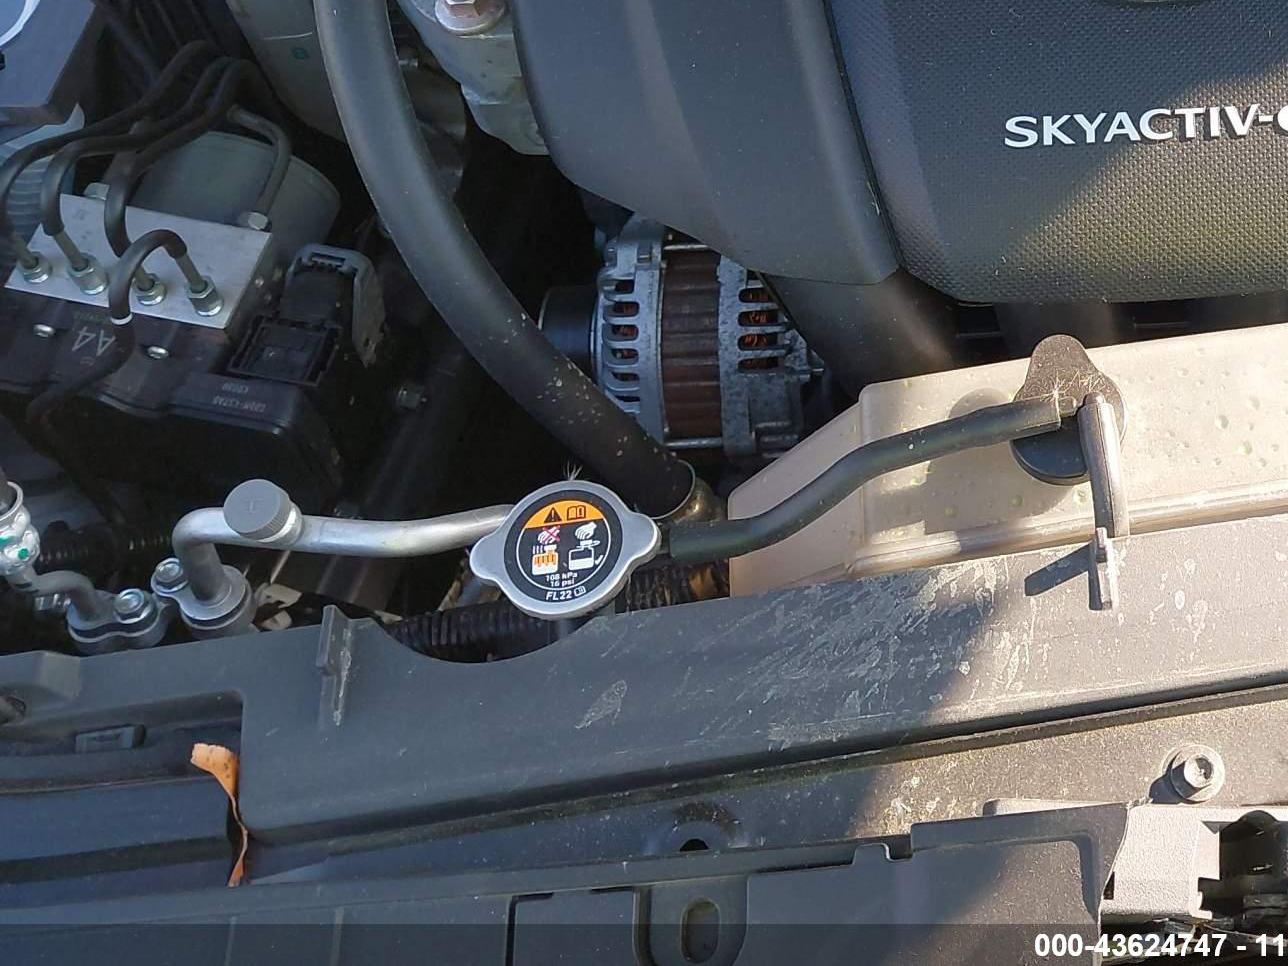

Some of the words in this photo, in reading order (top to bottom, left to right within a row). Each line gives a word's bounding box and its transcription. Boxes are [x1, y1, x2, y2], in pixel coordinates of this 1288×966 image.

[546, 574, 560, 582] 108
[561, 572, 578, 580] kPa
[562, 578, 575, 587] psi
[545, 590, 572, 601] FL22
